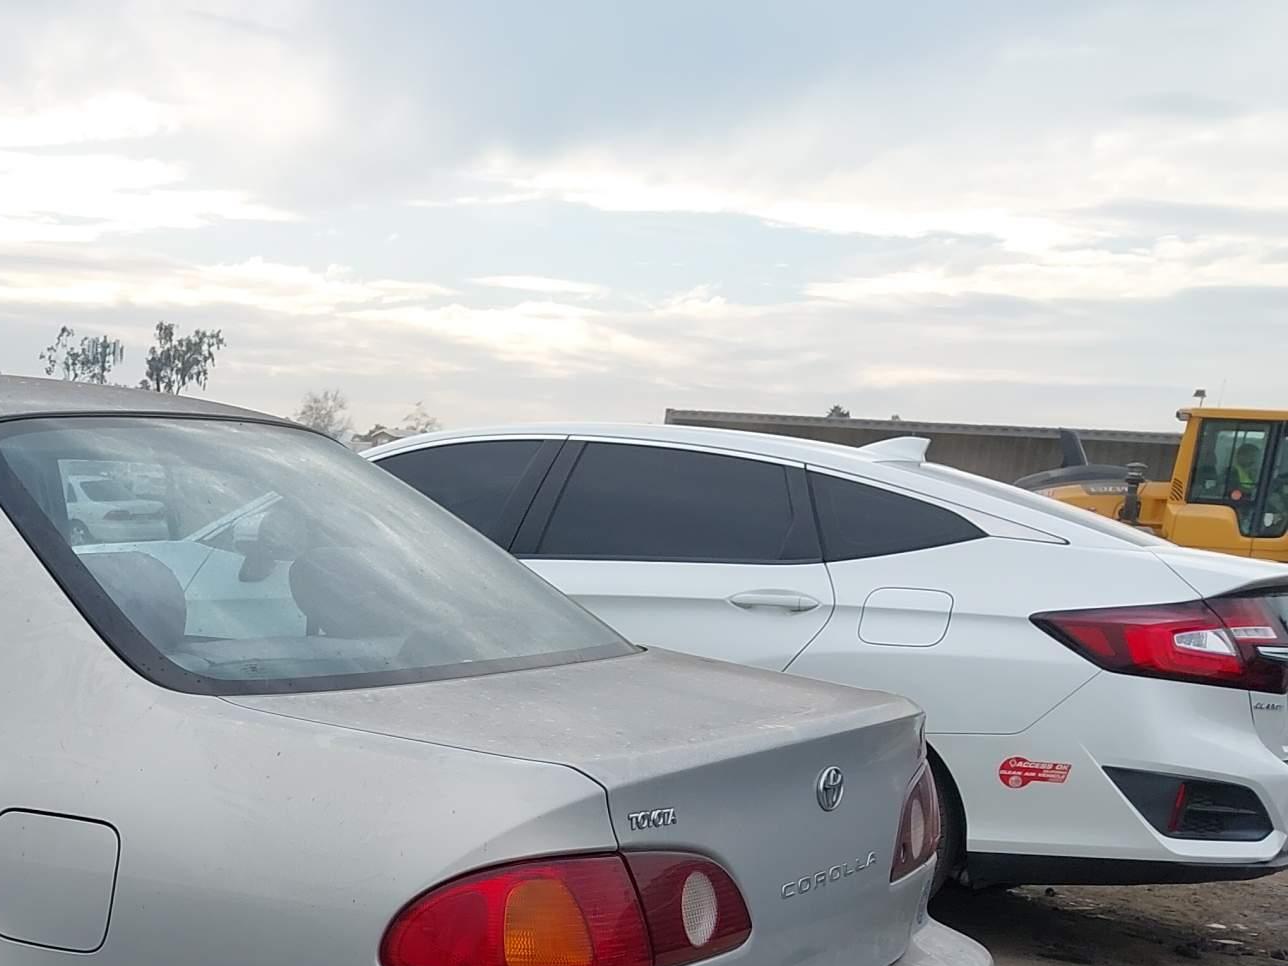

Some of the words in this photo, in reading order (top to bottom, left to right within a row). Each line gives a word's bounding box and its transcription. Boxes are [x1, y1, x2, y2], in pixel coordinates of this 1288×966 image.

[1016, 761, 1053, 769] ACCESS
[628, 806, 677, 831] TOYOTA
[781, 851, 876, 899] COROLLA
